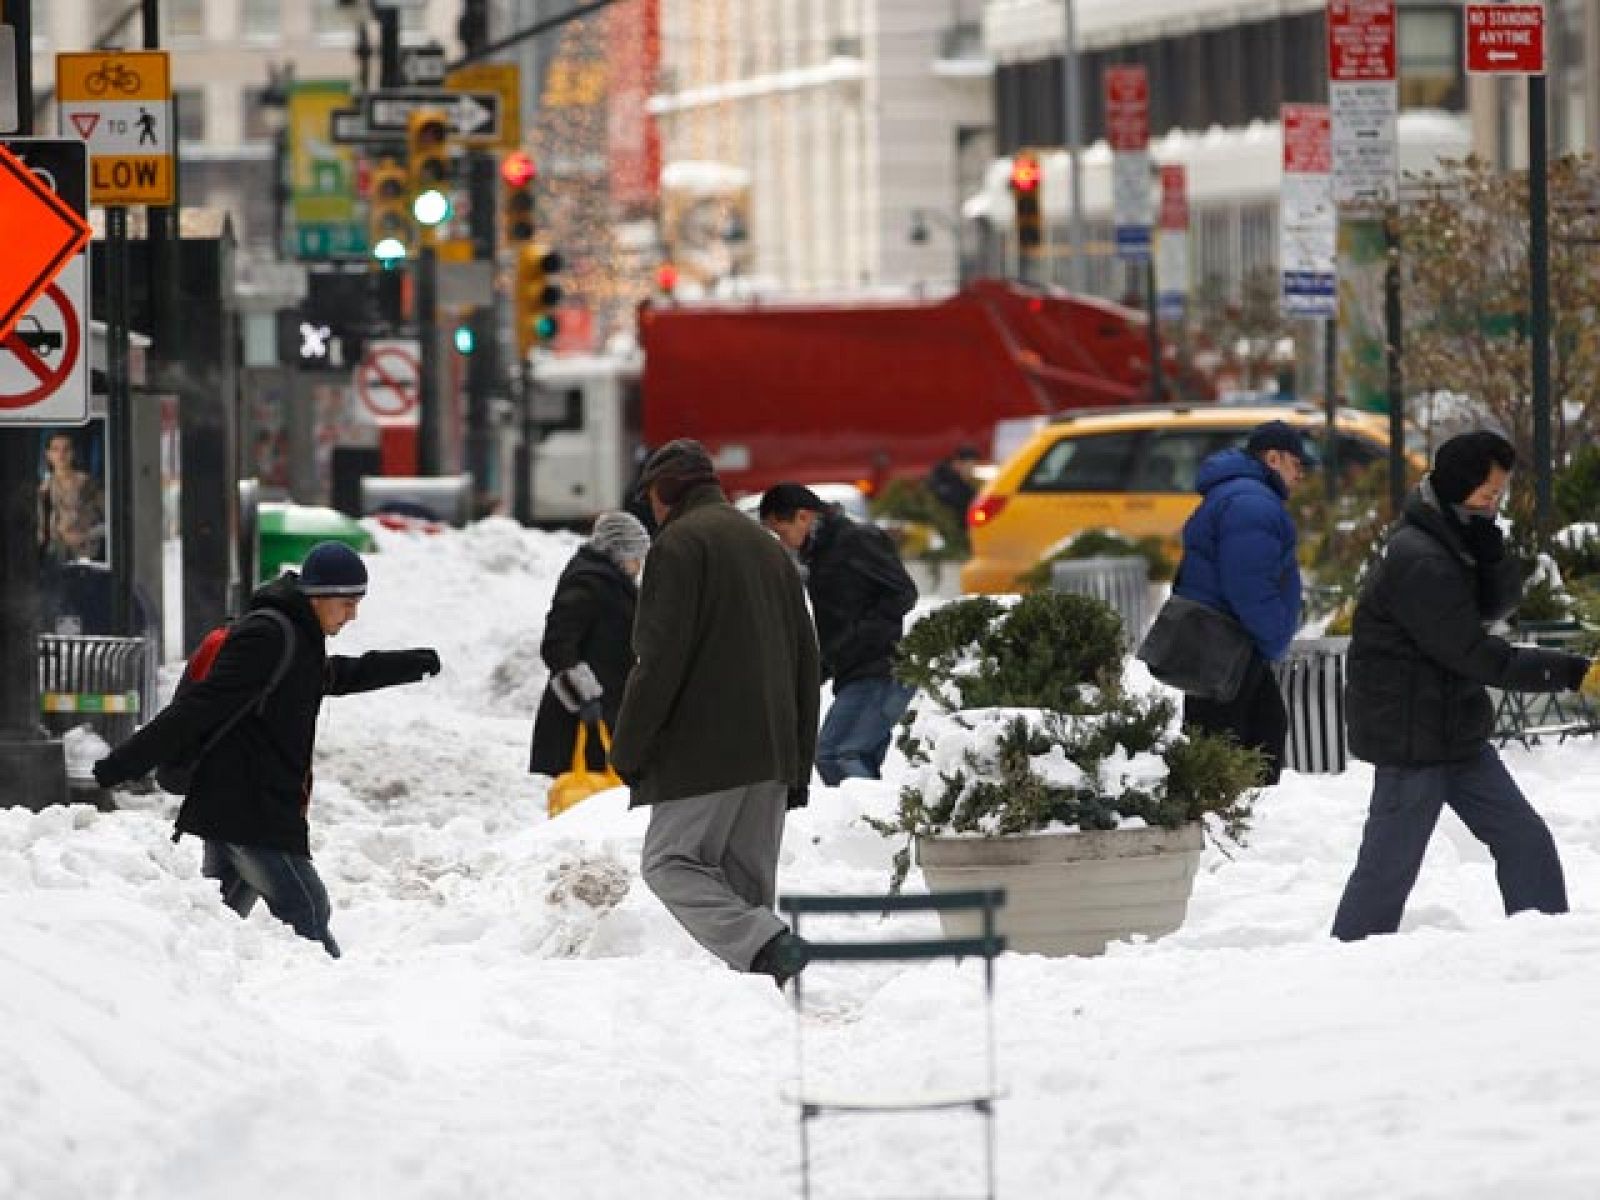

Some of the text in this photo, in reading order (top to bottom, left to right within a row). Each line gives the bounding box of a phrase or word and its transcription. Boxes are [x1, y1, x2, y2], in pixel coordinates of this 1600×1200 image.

[1470, 10, 1540, 26] NO STANDING
[1479, 31, 1531, 46] ANYTIME
[107, 119, 127, 135] TO
[92, 160, 158, 189] LOW
